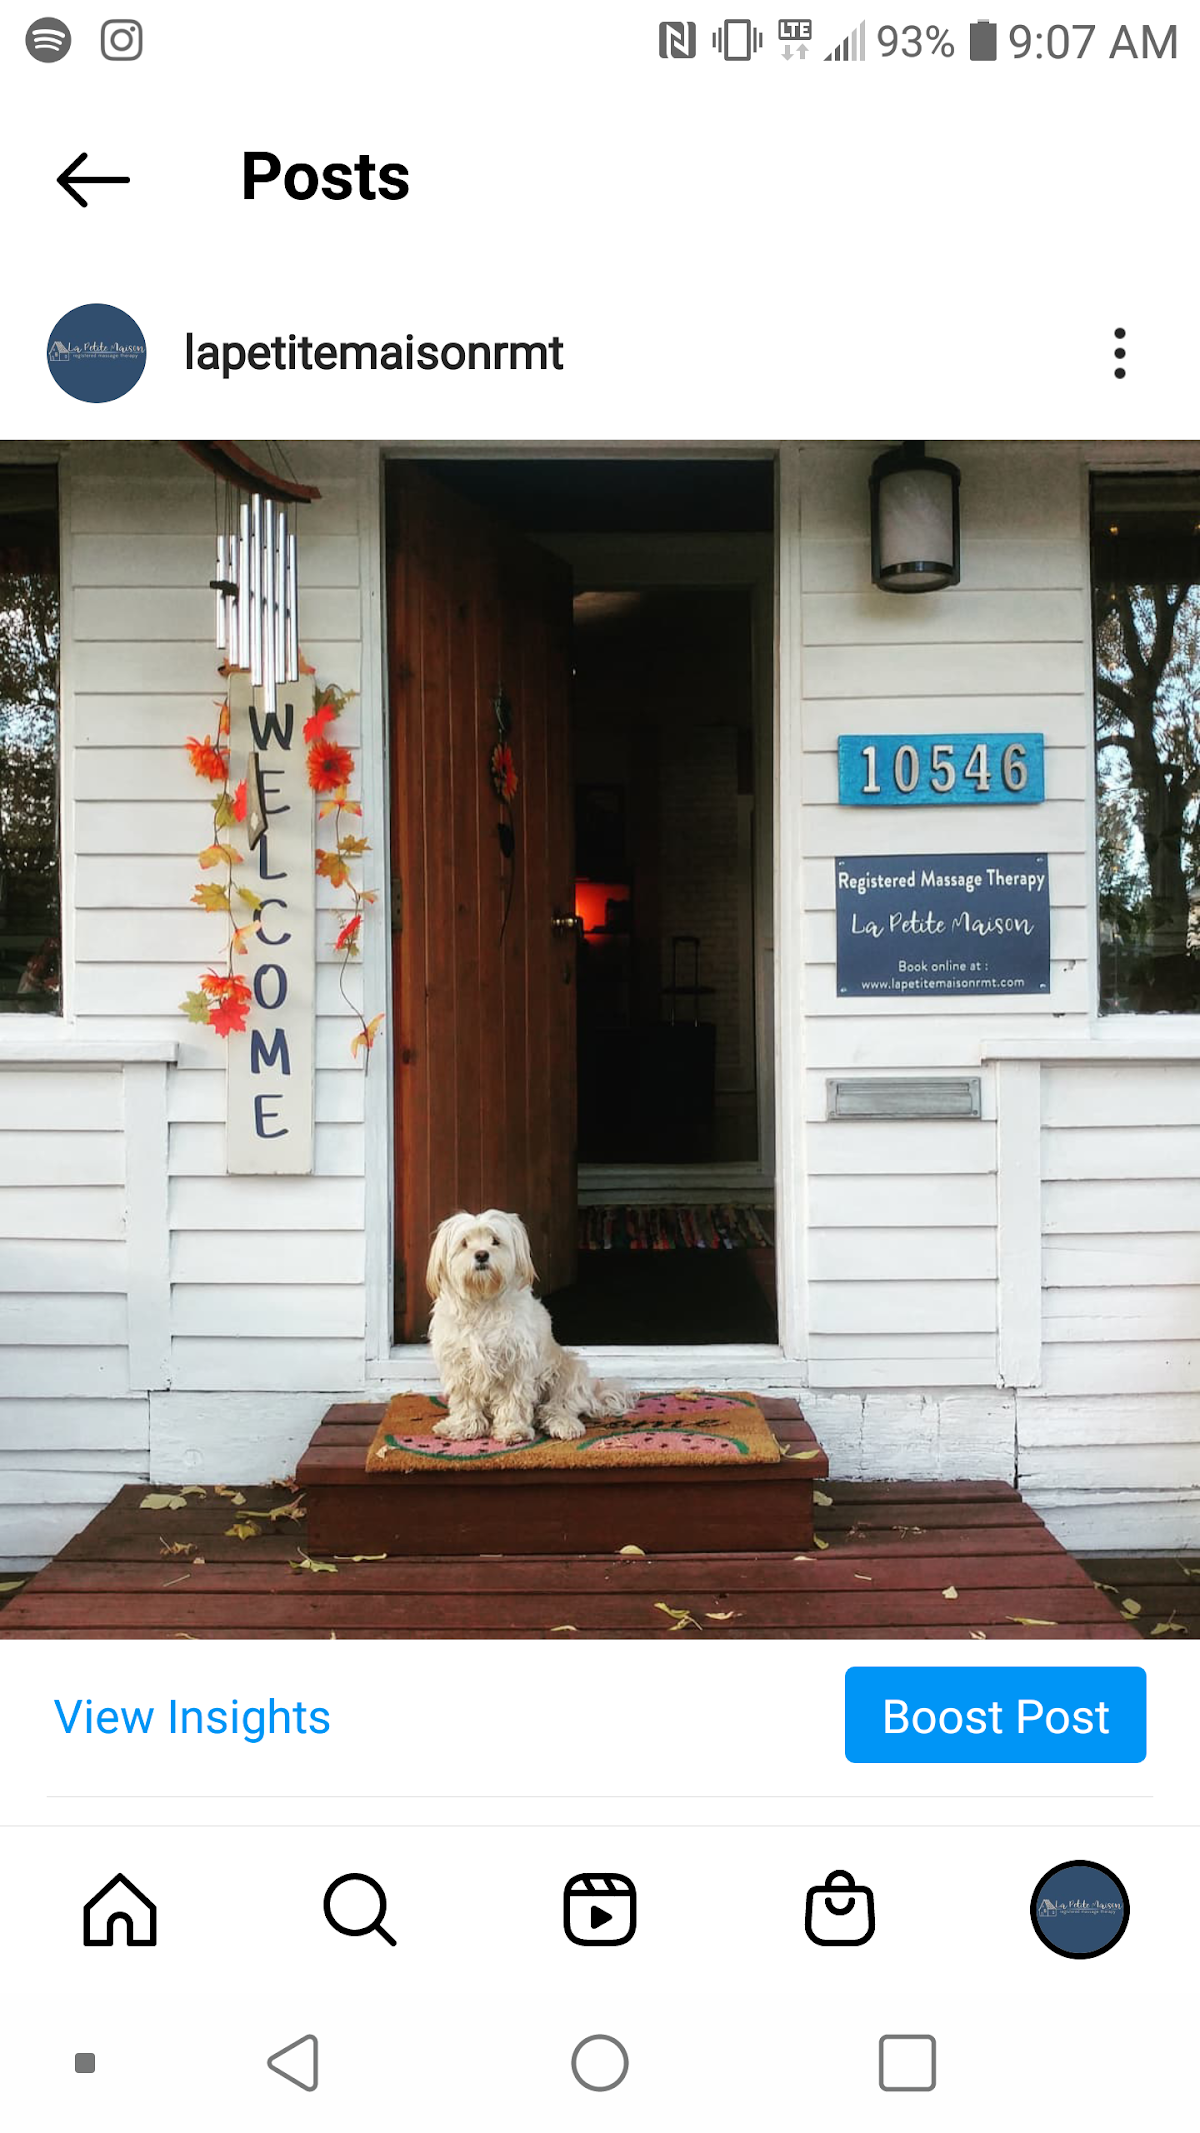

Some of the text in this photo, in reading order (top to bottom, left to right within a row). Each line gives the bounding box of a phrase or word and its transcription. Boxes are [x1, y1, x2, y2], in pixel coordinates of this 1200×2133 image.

[778, 19, 812, 40] LTE
[878, 25, 954, 58] 93%
[1010, 25, 1177, 59] 9:07 AM
[243, 151, 410, 201] Posts
[186, 331, 564, 379] lapetitemaisonrmt
[861, 744, 1028, 792] 10546
[838, 867, 1045, 894] Registered Massage Therapy
[248, 703, 295, 1139] WELCOME
[851, 910, 1034, 938] La Petite Maison
[898, 960, 928, 972] Book
[931, 960, 967, 972] online
[970, 961, 981, 971] at
[861, 977, 1025, 990] www.lapetitemaisonrmt.com
[53, 1697, 331, 1743] View Insights
[884, 1698, 1110, 1735] Boost Post
